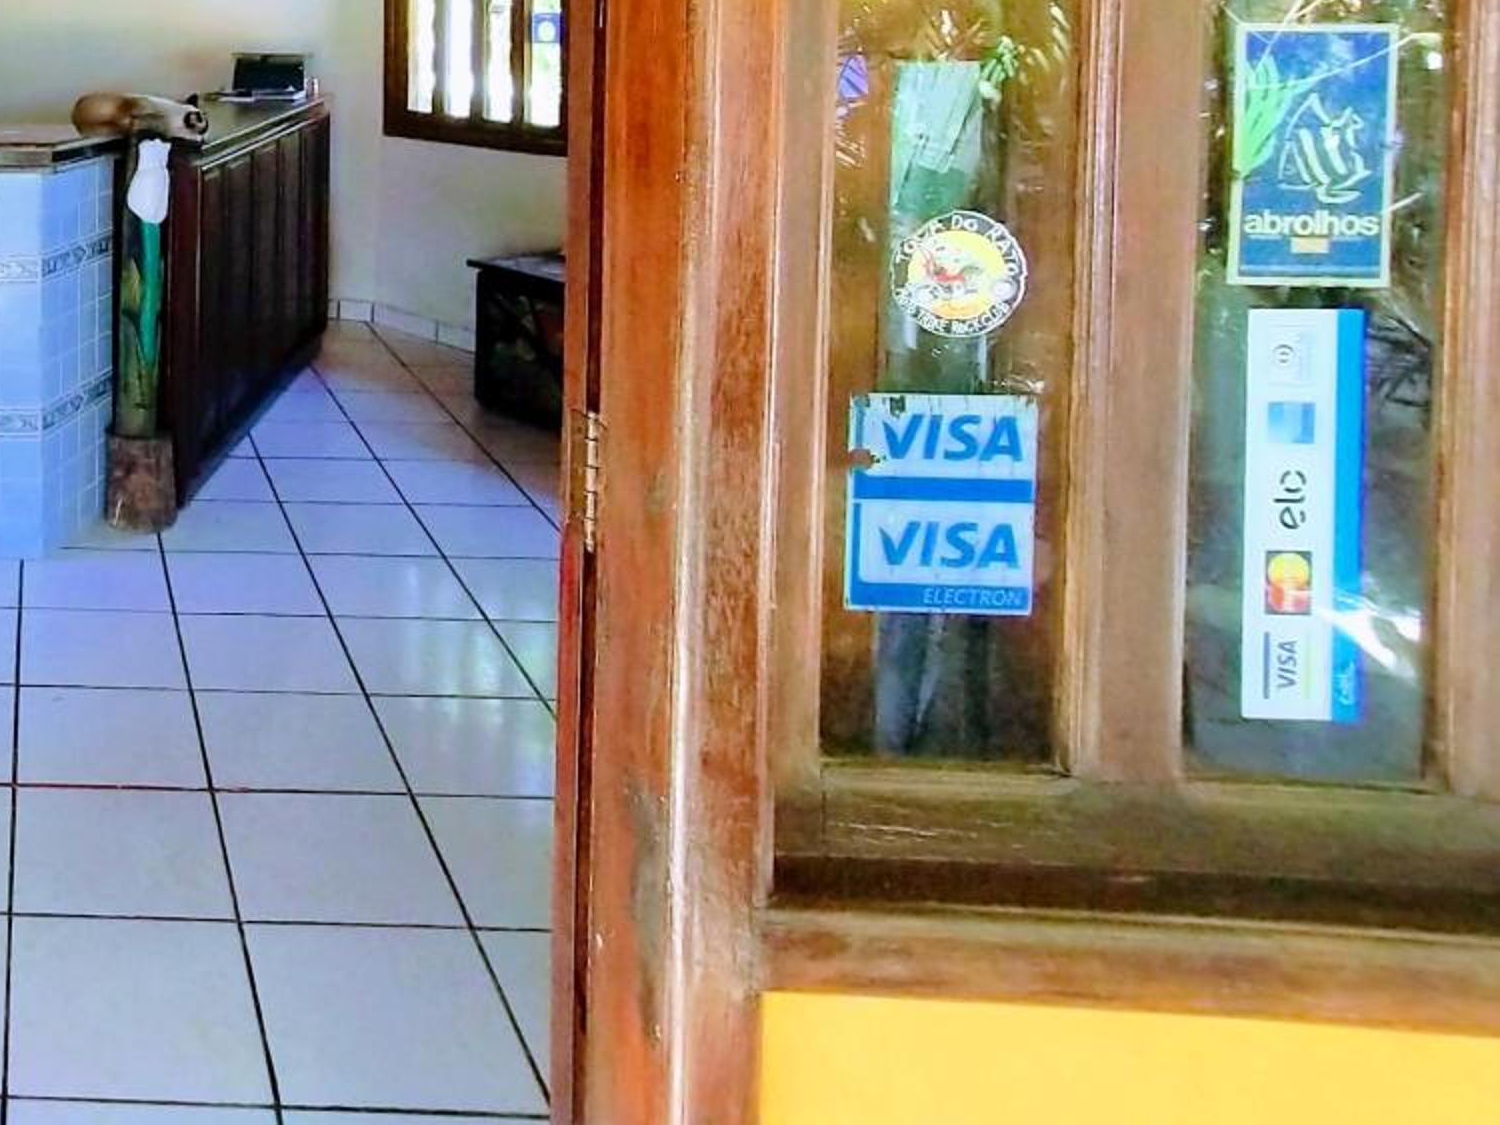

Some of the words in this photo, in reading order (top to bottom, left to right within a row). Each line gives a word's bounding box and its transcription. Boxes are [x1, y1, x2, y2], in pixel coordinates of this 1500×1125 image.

[1243, 209, 1380, 236] abrolhos
[985, 225, 1020, 273] RATO
[882, 414, 1023, 462] VISA
[878, 521, 1020, 569] VISA
[923, 587, 1022, 606] ELECTRON
[1277, 640, 1297, 689] VISA
